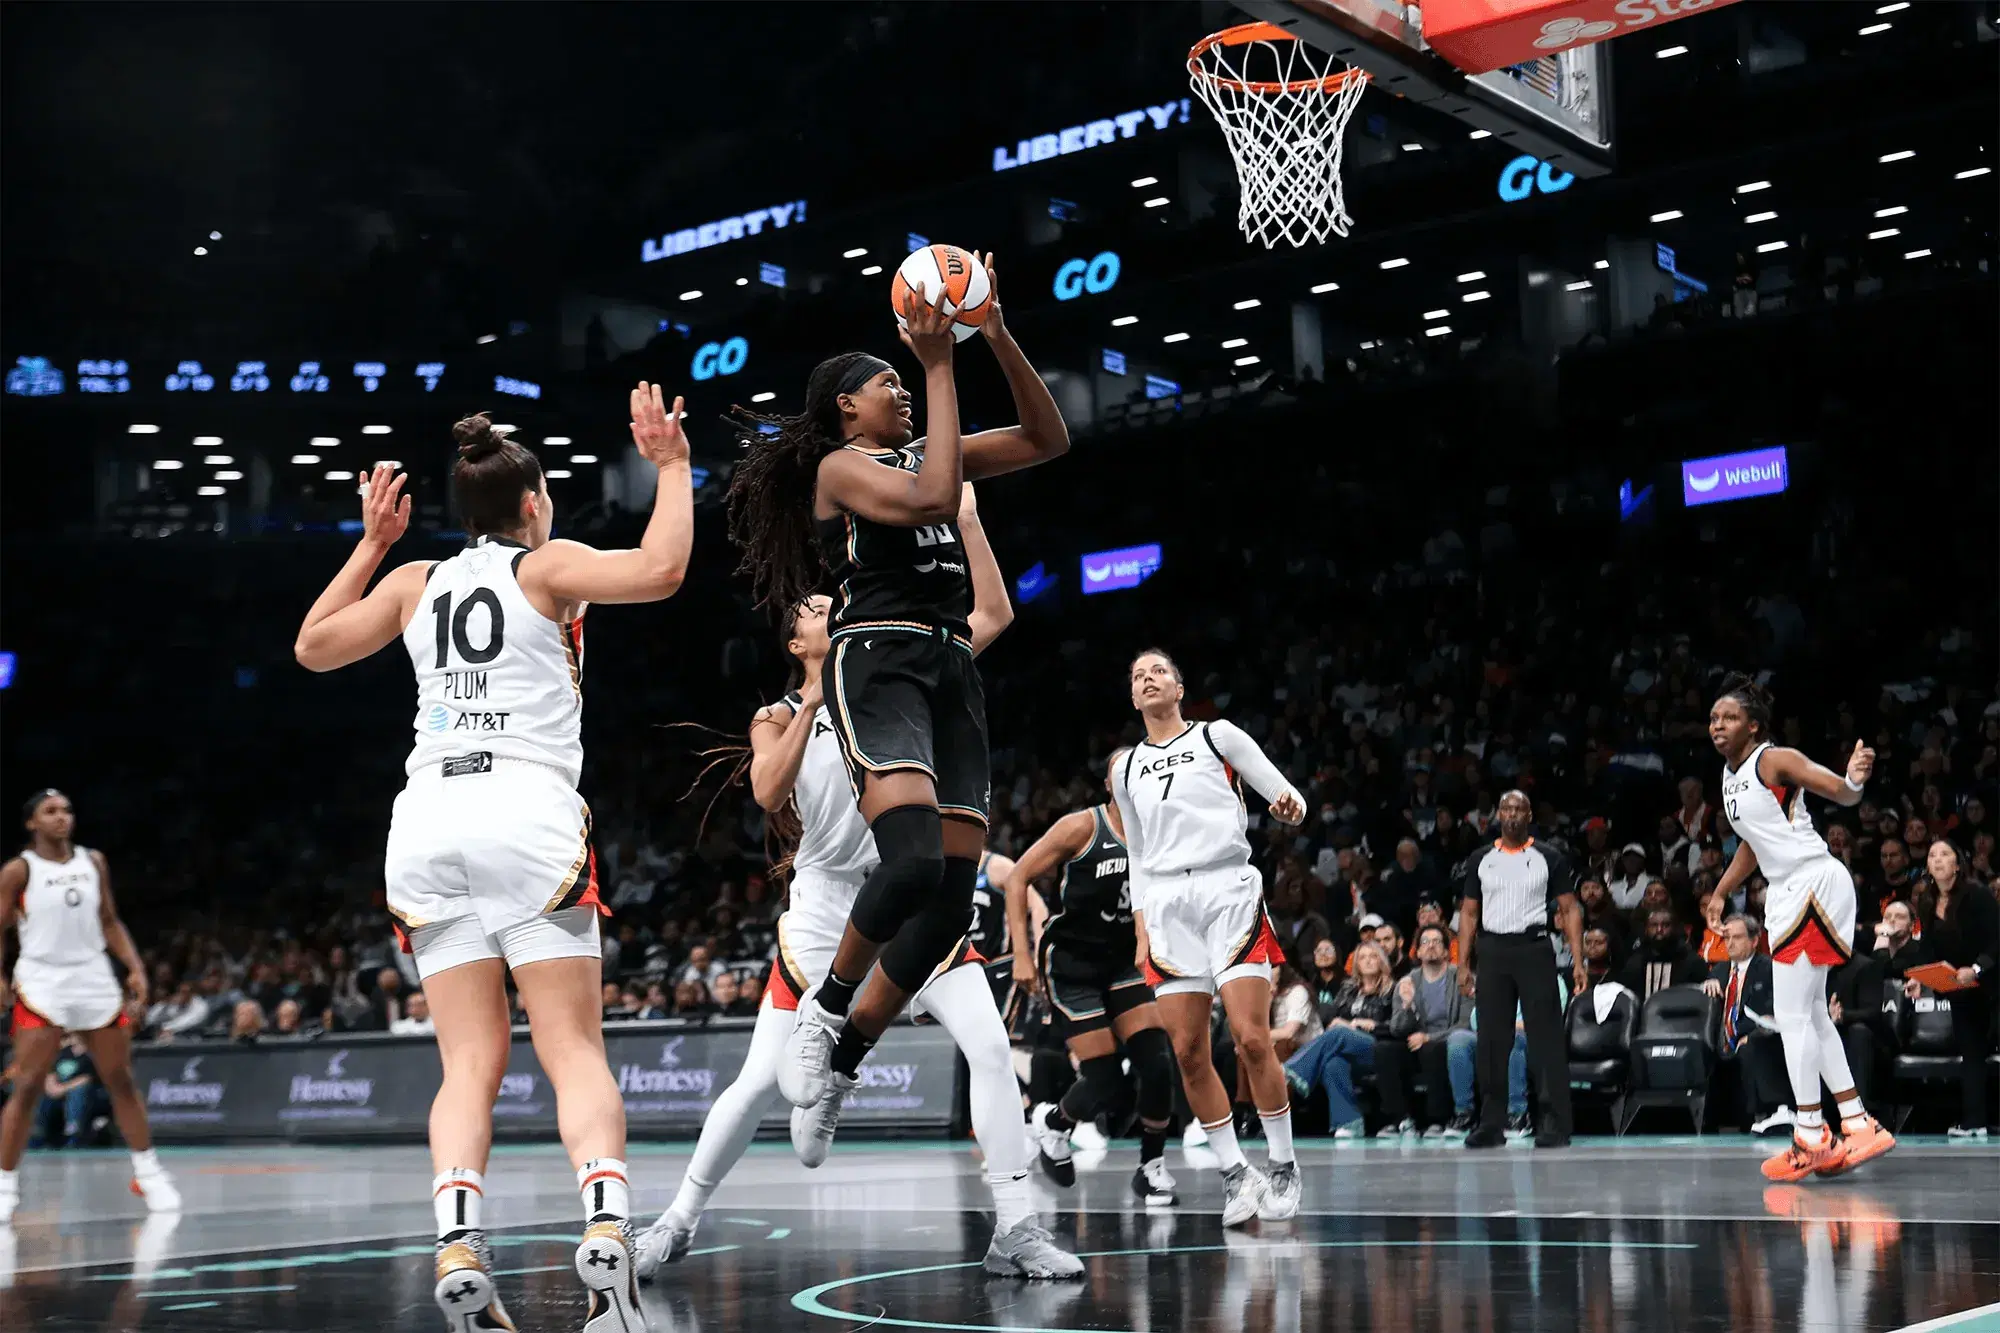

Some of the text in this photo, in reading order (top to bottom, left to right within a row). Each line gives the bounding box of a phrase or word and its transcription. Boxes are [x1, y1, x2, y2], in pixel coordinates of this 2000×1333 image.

[992, 98, 1191, 172] LIBERTY!
[1498, 154, 1575, 203] GO
[641, 200, 807, 262] LIBERTY!
[1053, 251, 1121, 301] GO
[690, 336, 749, 381] GO
[1724, 460, 1781, 486] Webull
[432, 587, 505, 669] 10
[444, 671, 488, 700] PLUM
[454, 711, 510, 731] AT&T
[1139, 751, 1195, 779] ACES
[1158, 772, 1175, 801] 7
[1726, 798, 1741, 823] 12
[1095, 857, 1127, 879] NEW
